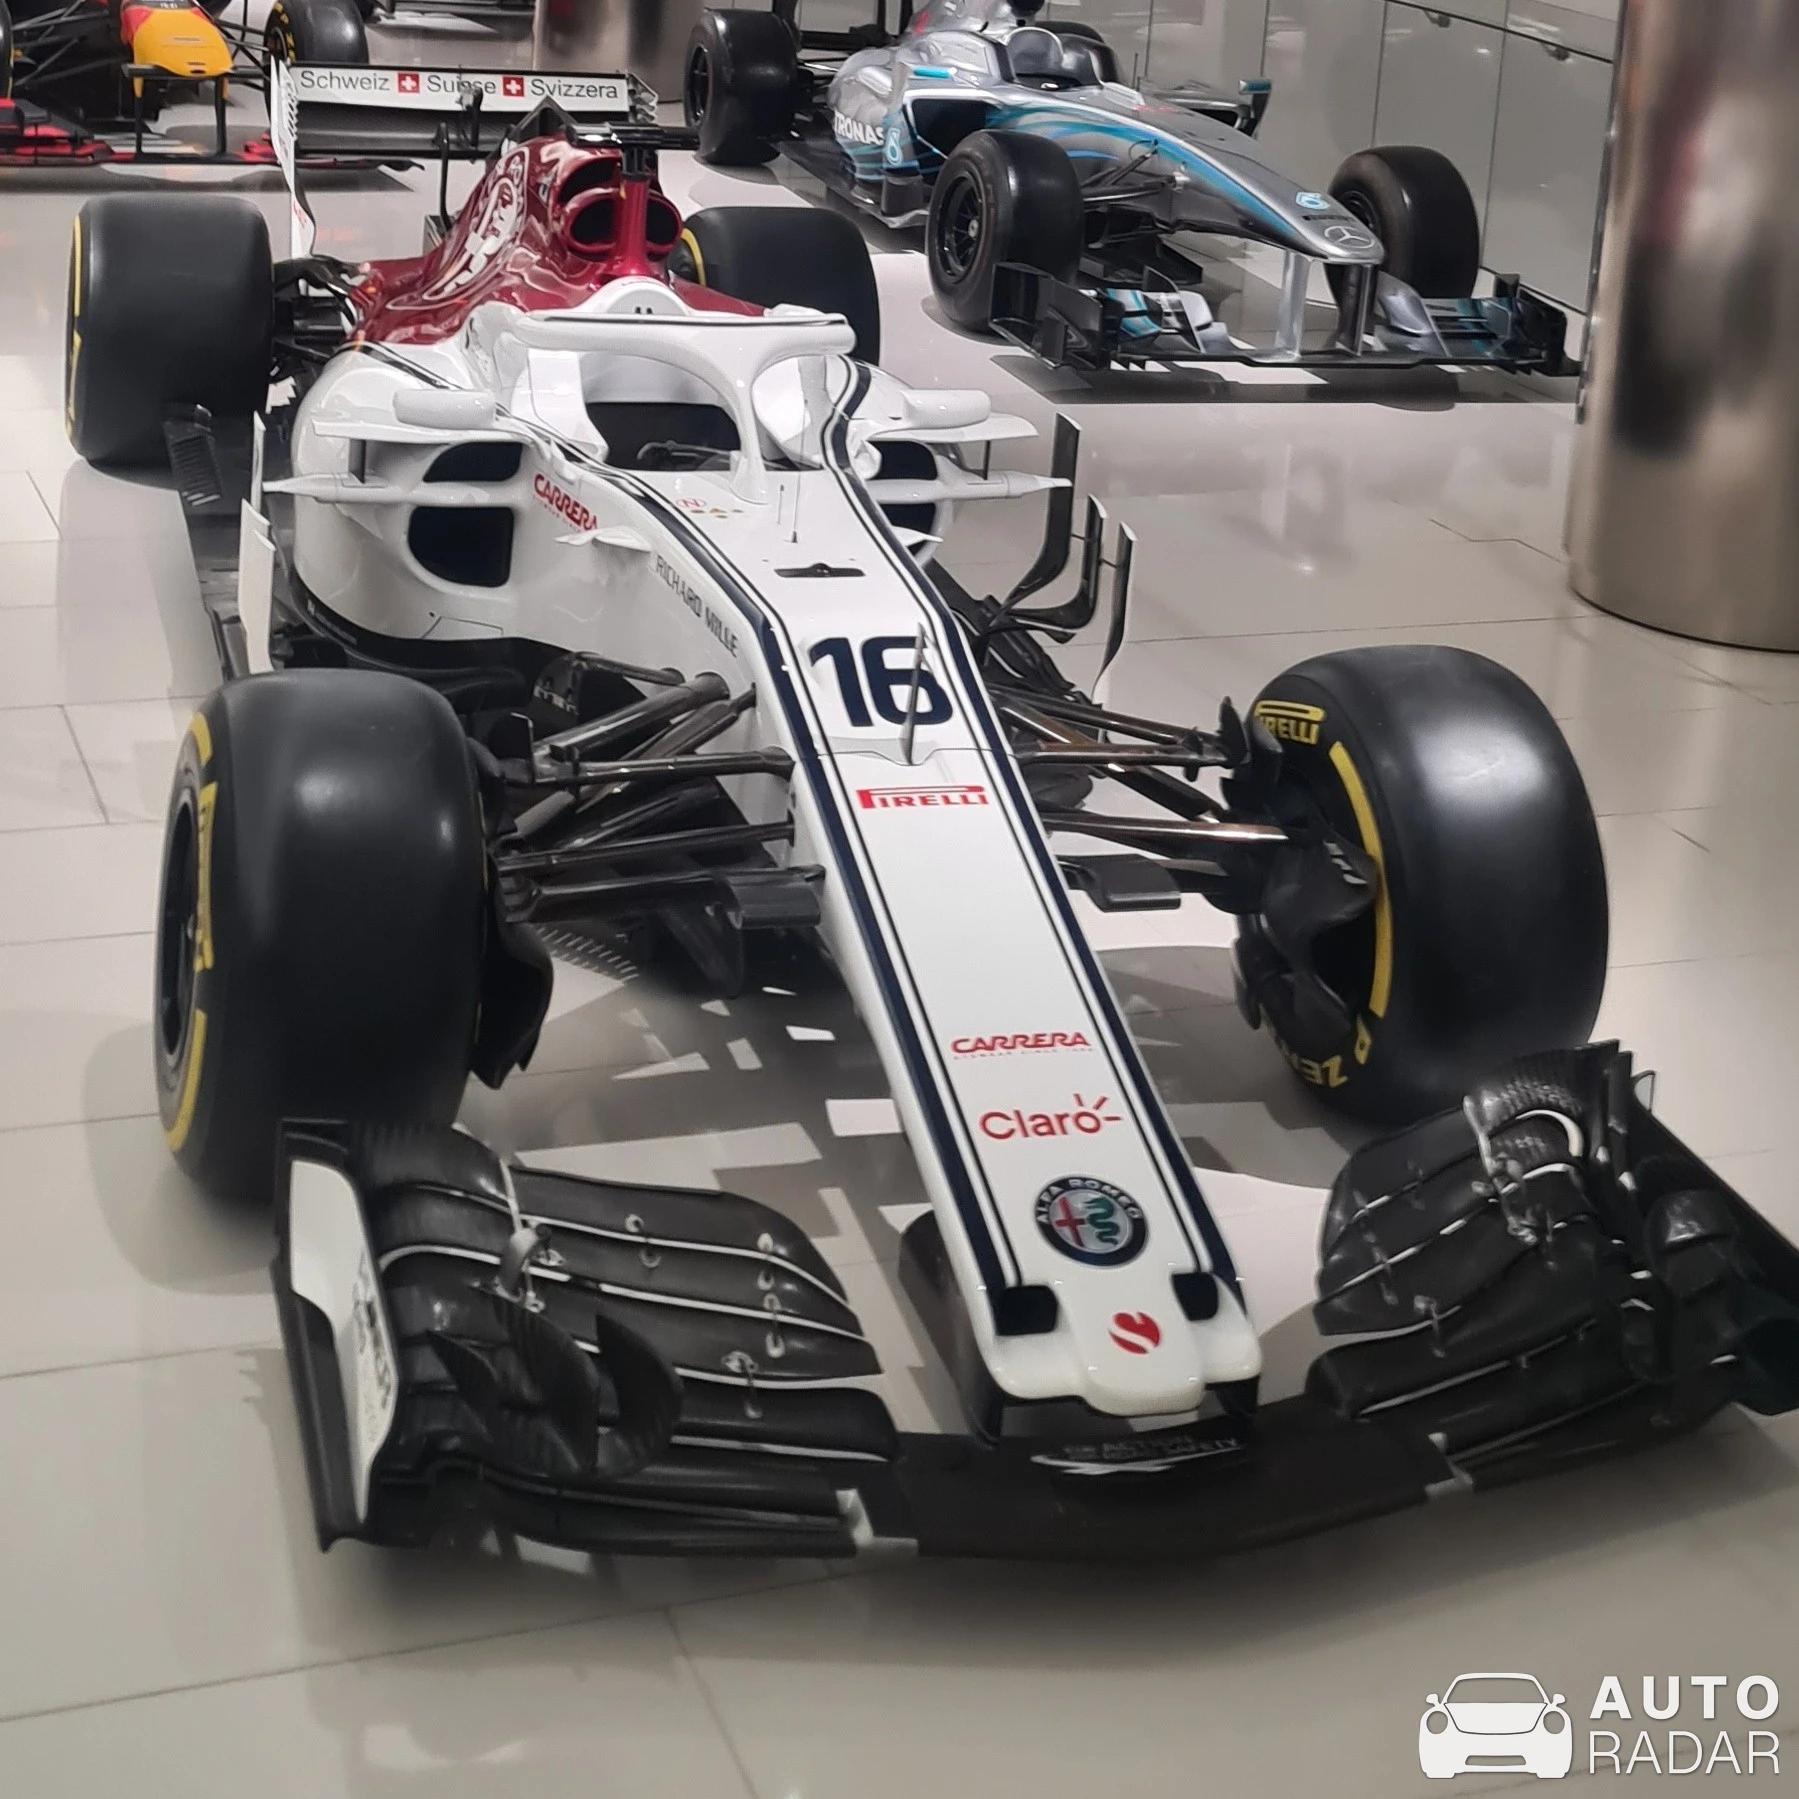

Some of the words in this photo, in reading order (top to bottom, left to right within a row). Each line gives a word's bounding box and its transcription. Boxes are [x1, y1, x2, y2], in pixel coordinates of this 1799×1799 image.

[300, 70, 390, 92] Schweiz
[530, 78, 618, 99] Svizzera
[656, 554, 702, 618] RICHARD
[809, 635, 953, 728] 16
[856, 785, 989, 809] PIRELLI
[951, 1031, 1092, 1054] CARRERA
[979, 1108, 1102, 1140] Claro
[1035, 1185, 1064, 1225] ALFA
[1068, 1178, 1144, 1220] ROMEO
